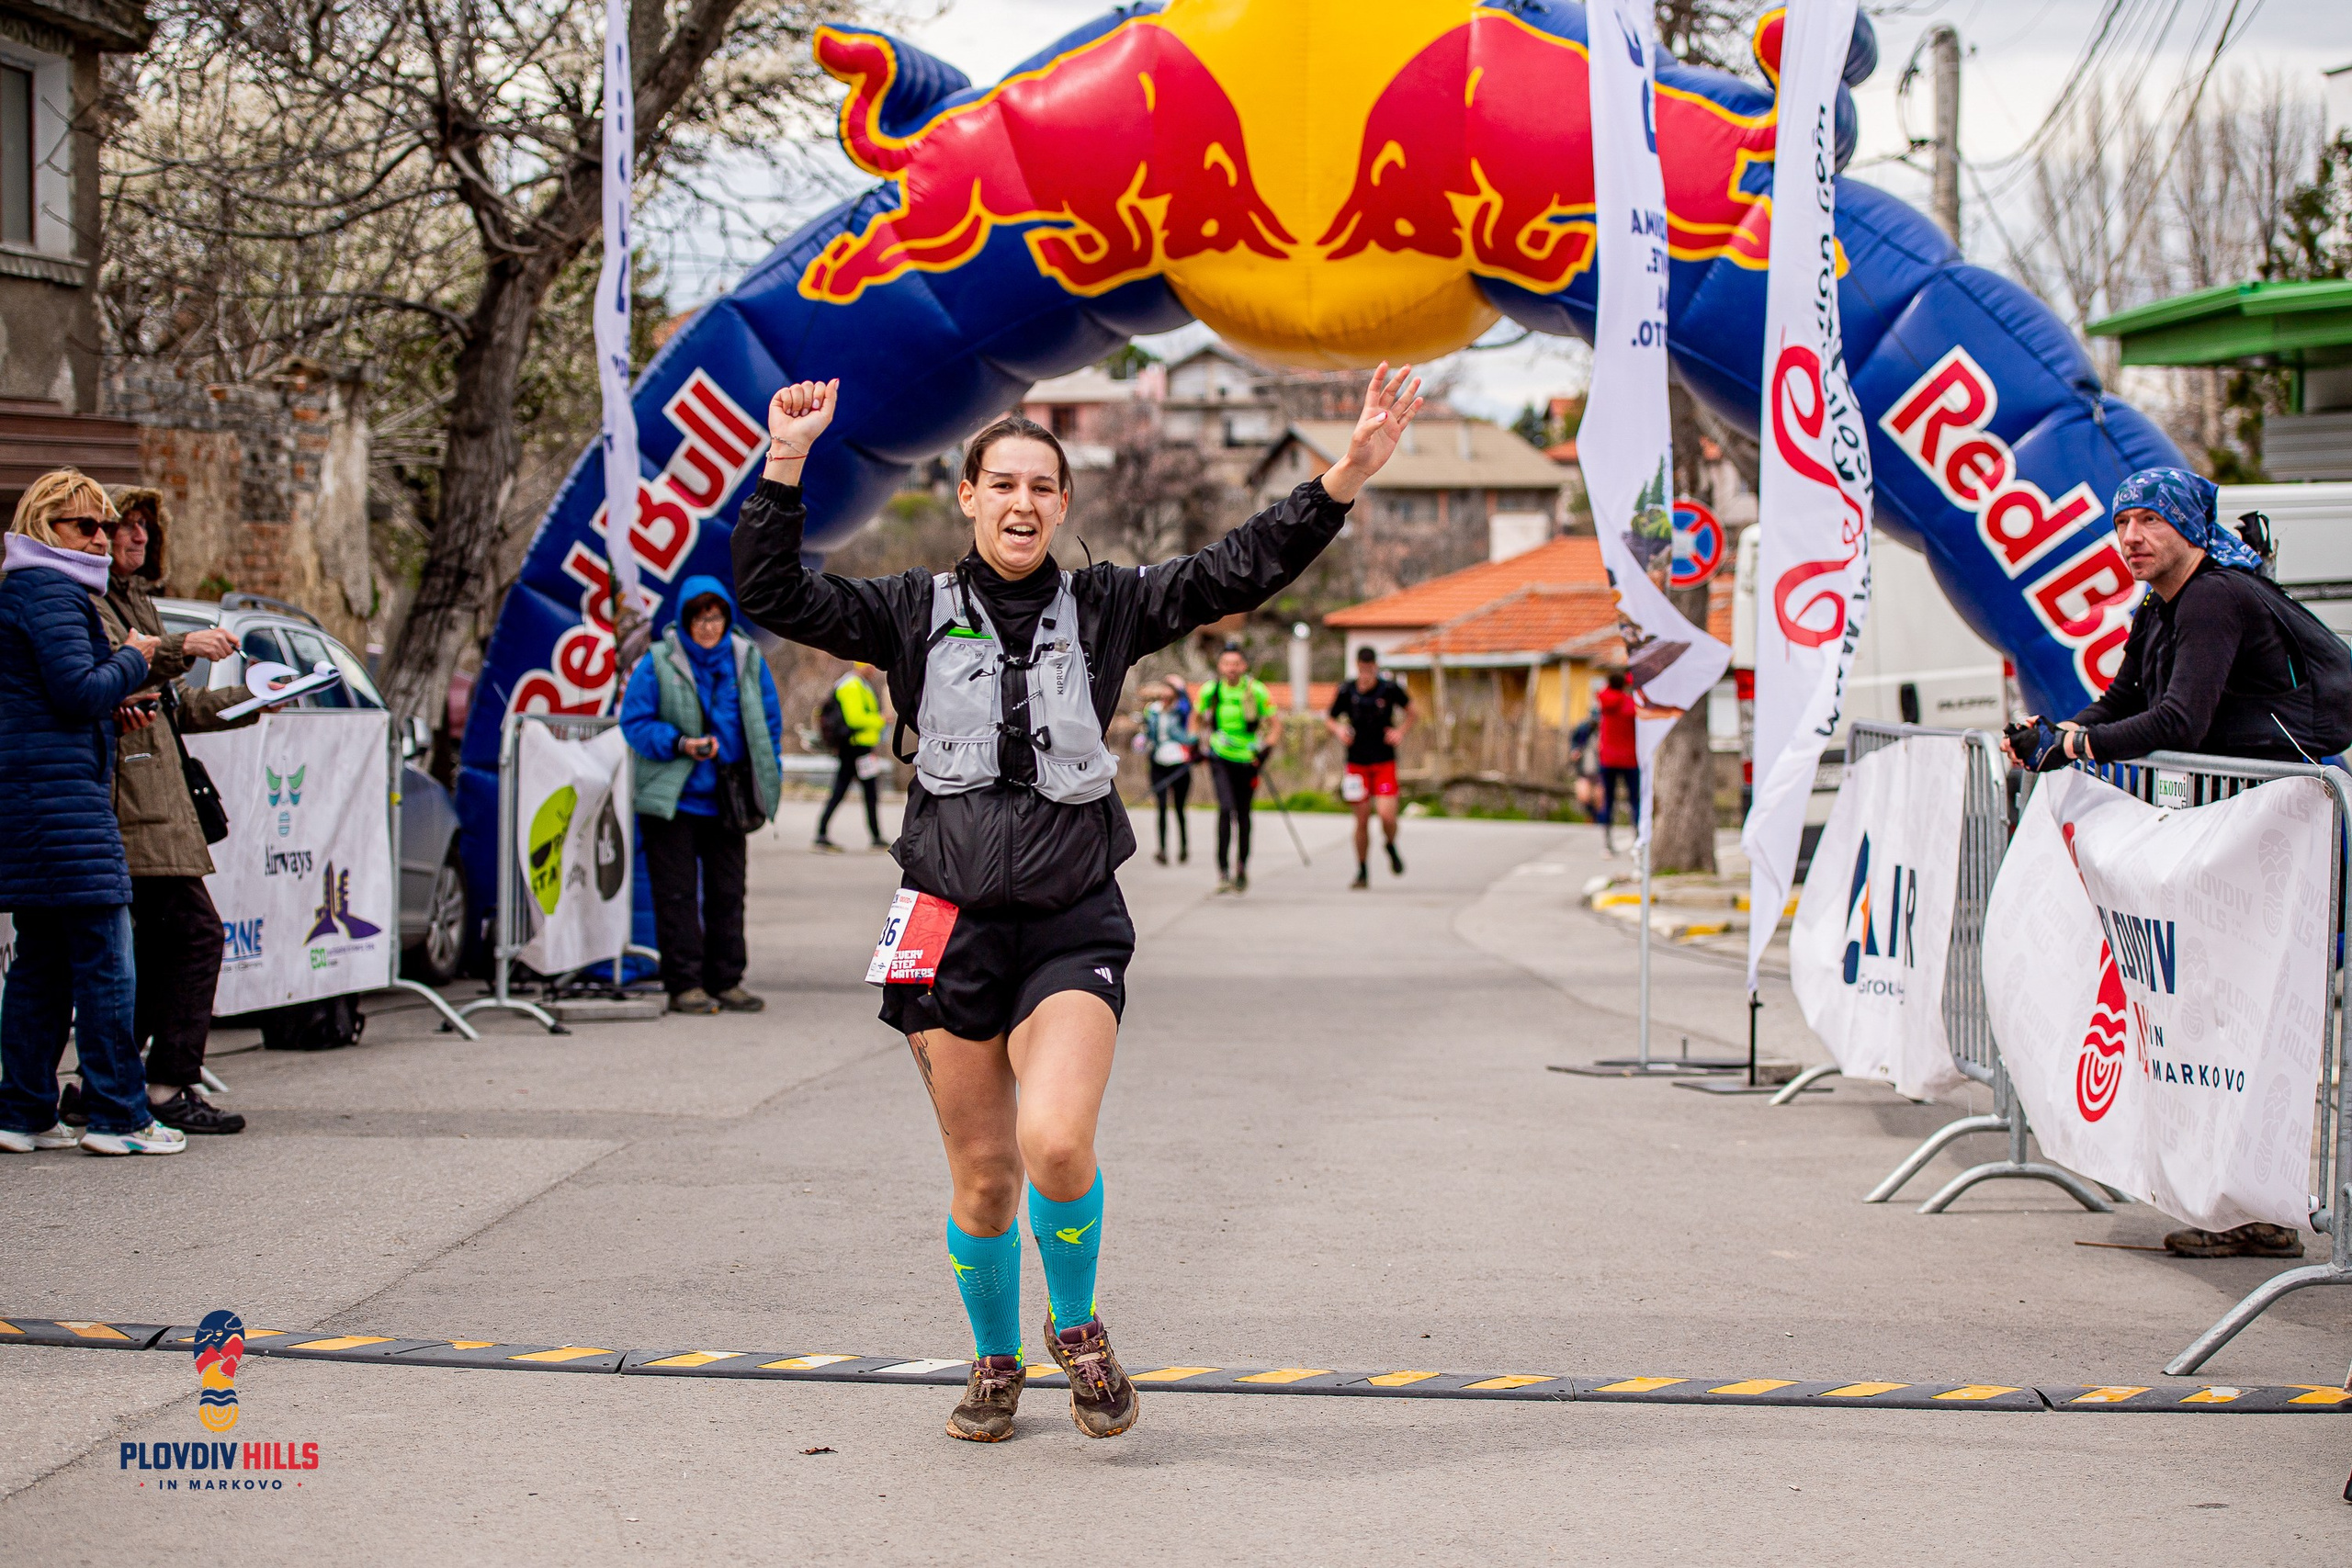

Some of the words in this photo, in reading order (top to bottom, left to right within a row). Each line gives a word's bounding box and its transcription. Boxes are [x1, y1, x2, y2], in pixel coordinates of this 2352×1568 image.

[595, 374, 766, 577] Bull
[1885, 353, 2098, 571] Red
[2030, 539, 2141, 696] Bu
[1056, 662, 1064, 695] KIPRUN
[891, 960, 915, 969] STEP
[894, 950, 923, 960] EVERY
[891, 968, 933, 979] MATTERS
[2150, 1024, 2164, 1047] IN
[2153, 1059, 2245, 1093] MARKOVO
